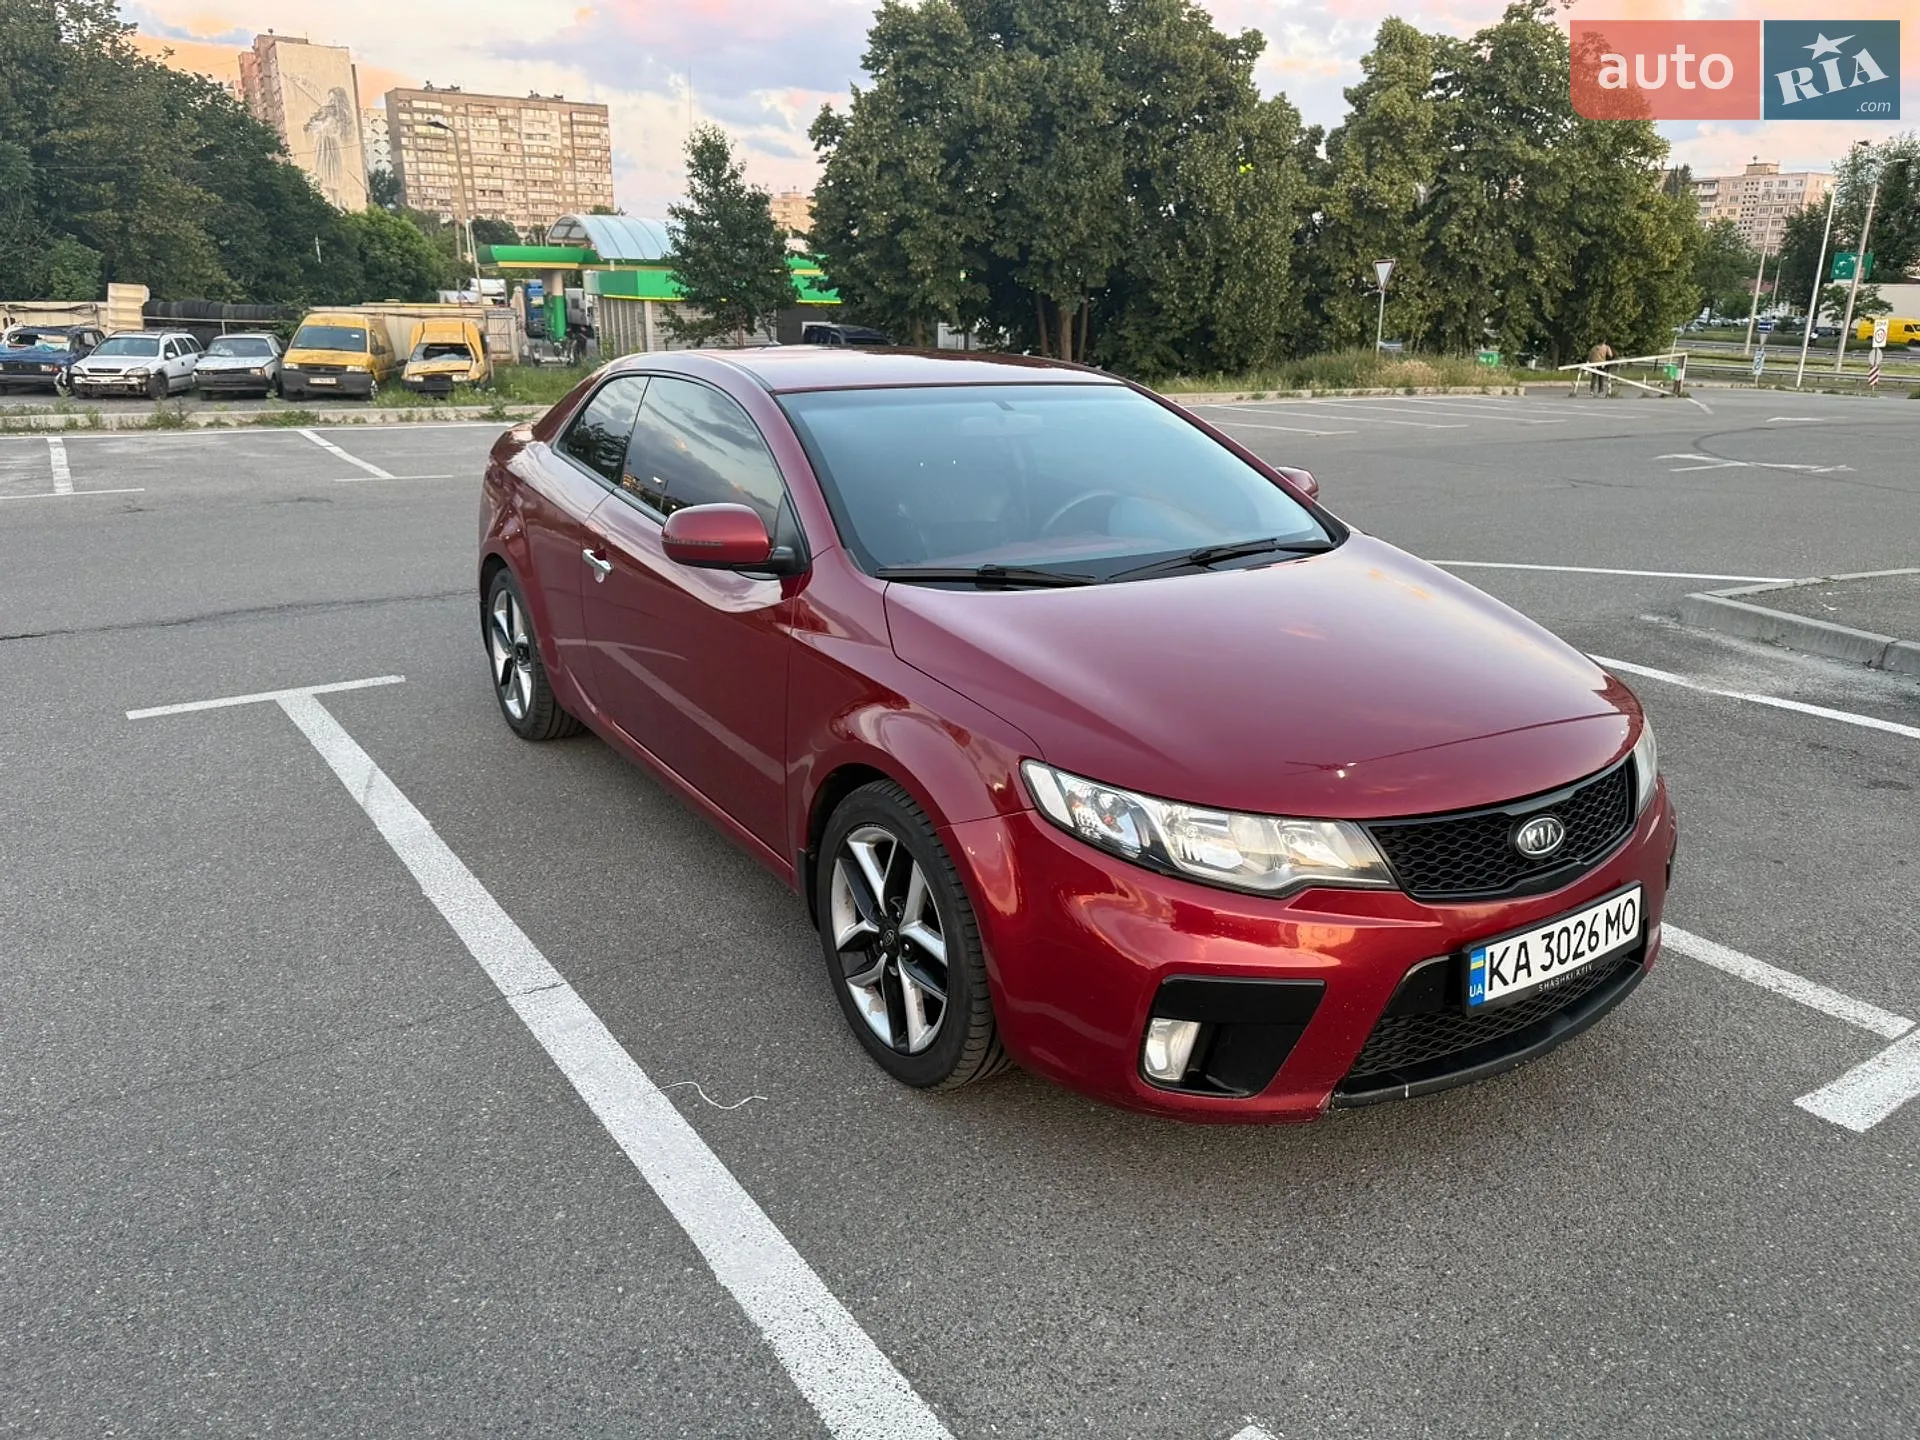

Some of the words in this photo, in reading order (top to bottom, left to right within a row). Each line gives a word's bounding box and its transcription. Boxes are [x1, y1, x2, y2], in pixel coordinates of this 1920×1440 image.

[1525, 823, 1558, 850] KIA
[1488, 941, 1532, 991] KA
[1540, 913, 1599, 972] 3026
[1605, 898, 1636, 947] MO
[1469, 985, 1483, 997] UA
